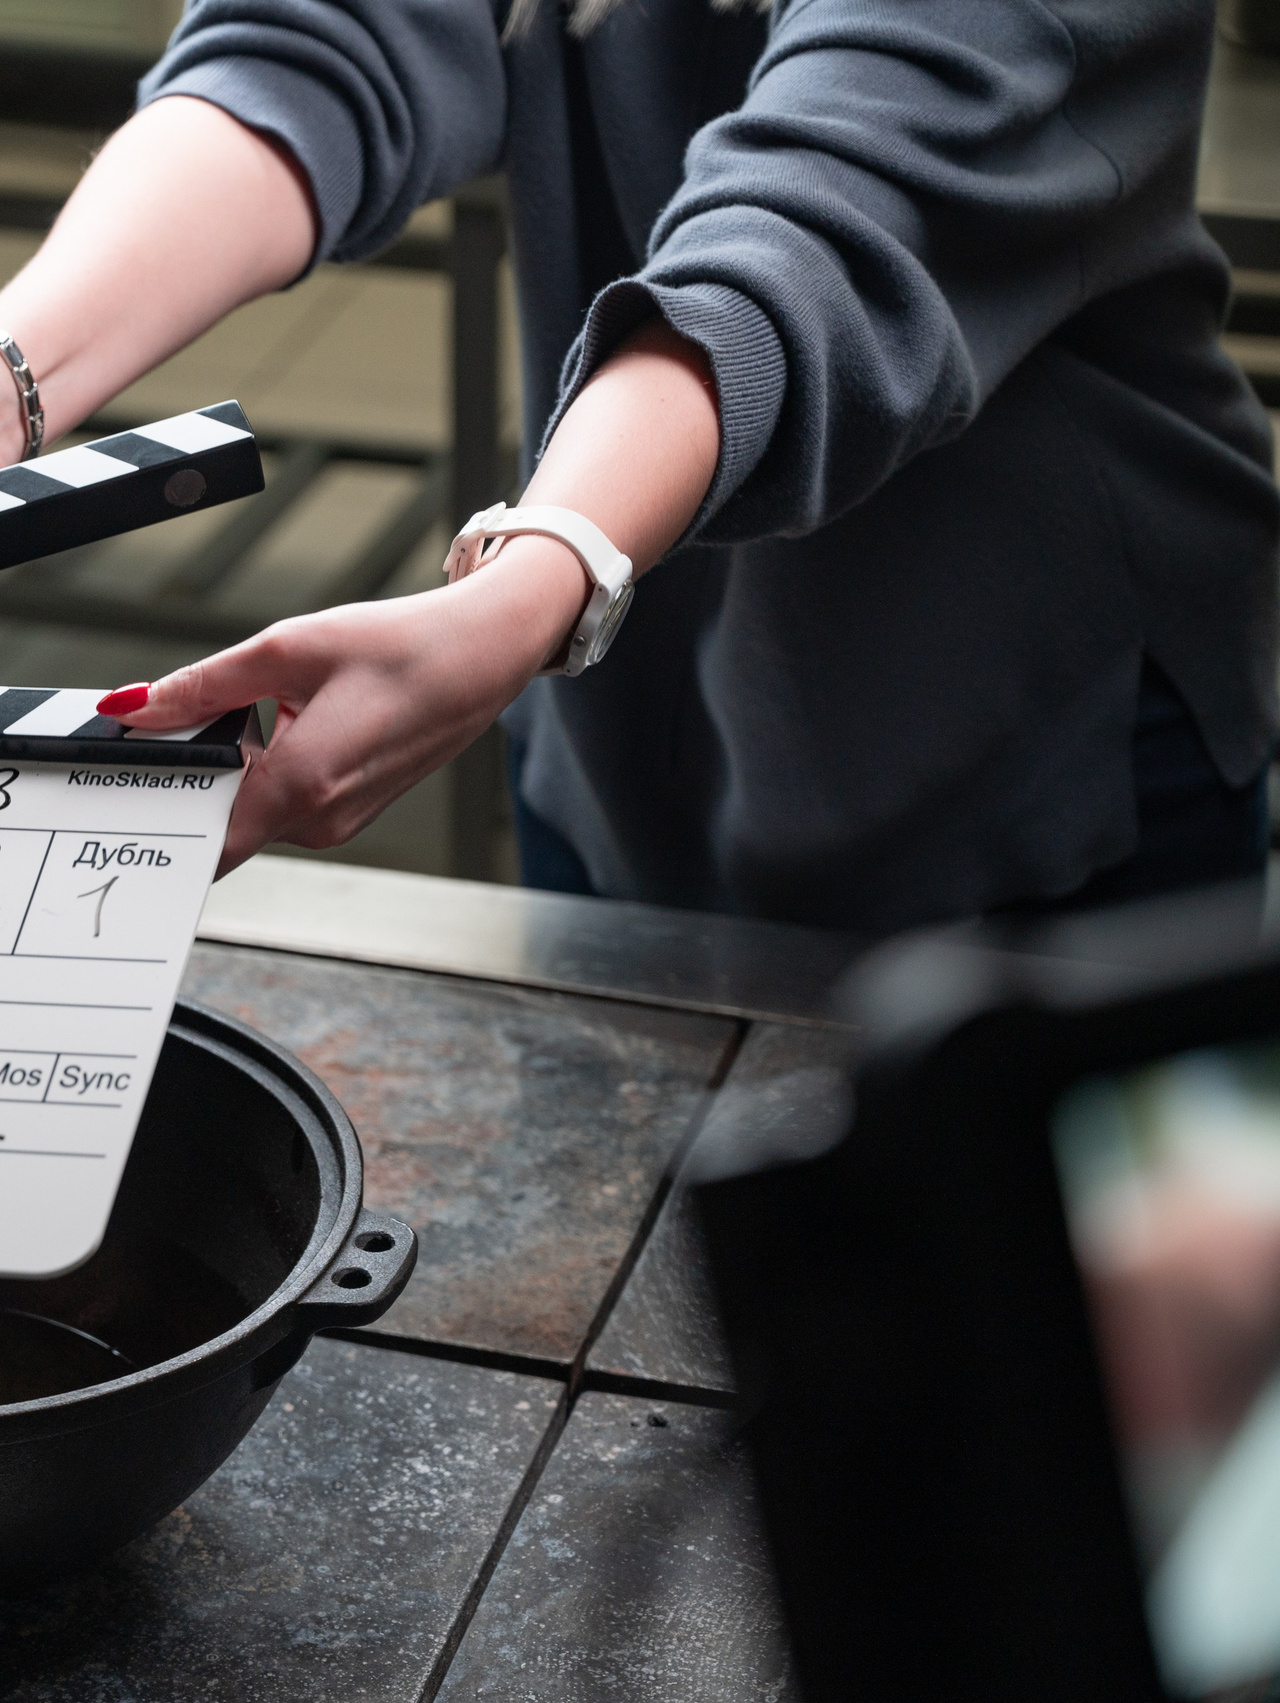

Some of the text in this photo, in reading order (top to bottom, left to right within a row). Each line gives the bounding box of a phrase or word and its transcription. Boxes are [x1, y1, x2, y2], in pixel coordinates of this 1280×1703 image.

[67, 769, 216, 792] KinoSklad.RU
[72, 841, 172, 870] Дубль
[77, 875, 120, 937] 1
[59, 1065, 131, 1093] Sync
